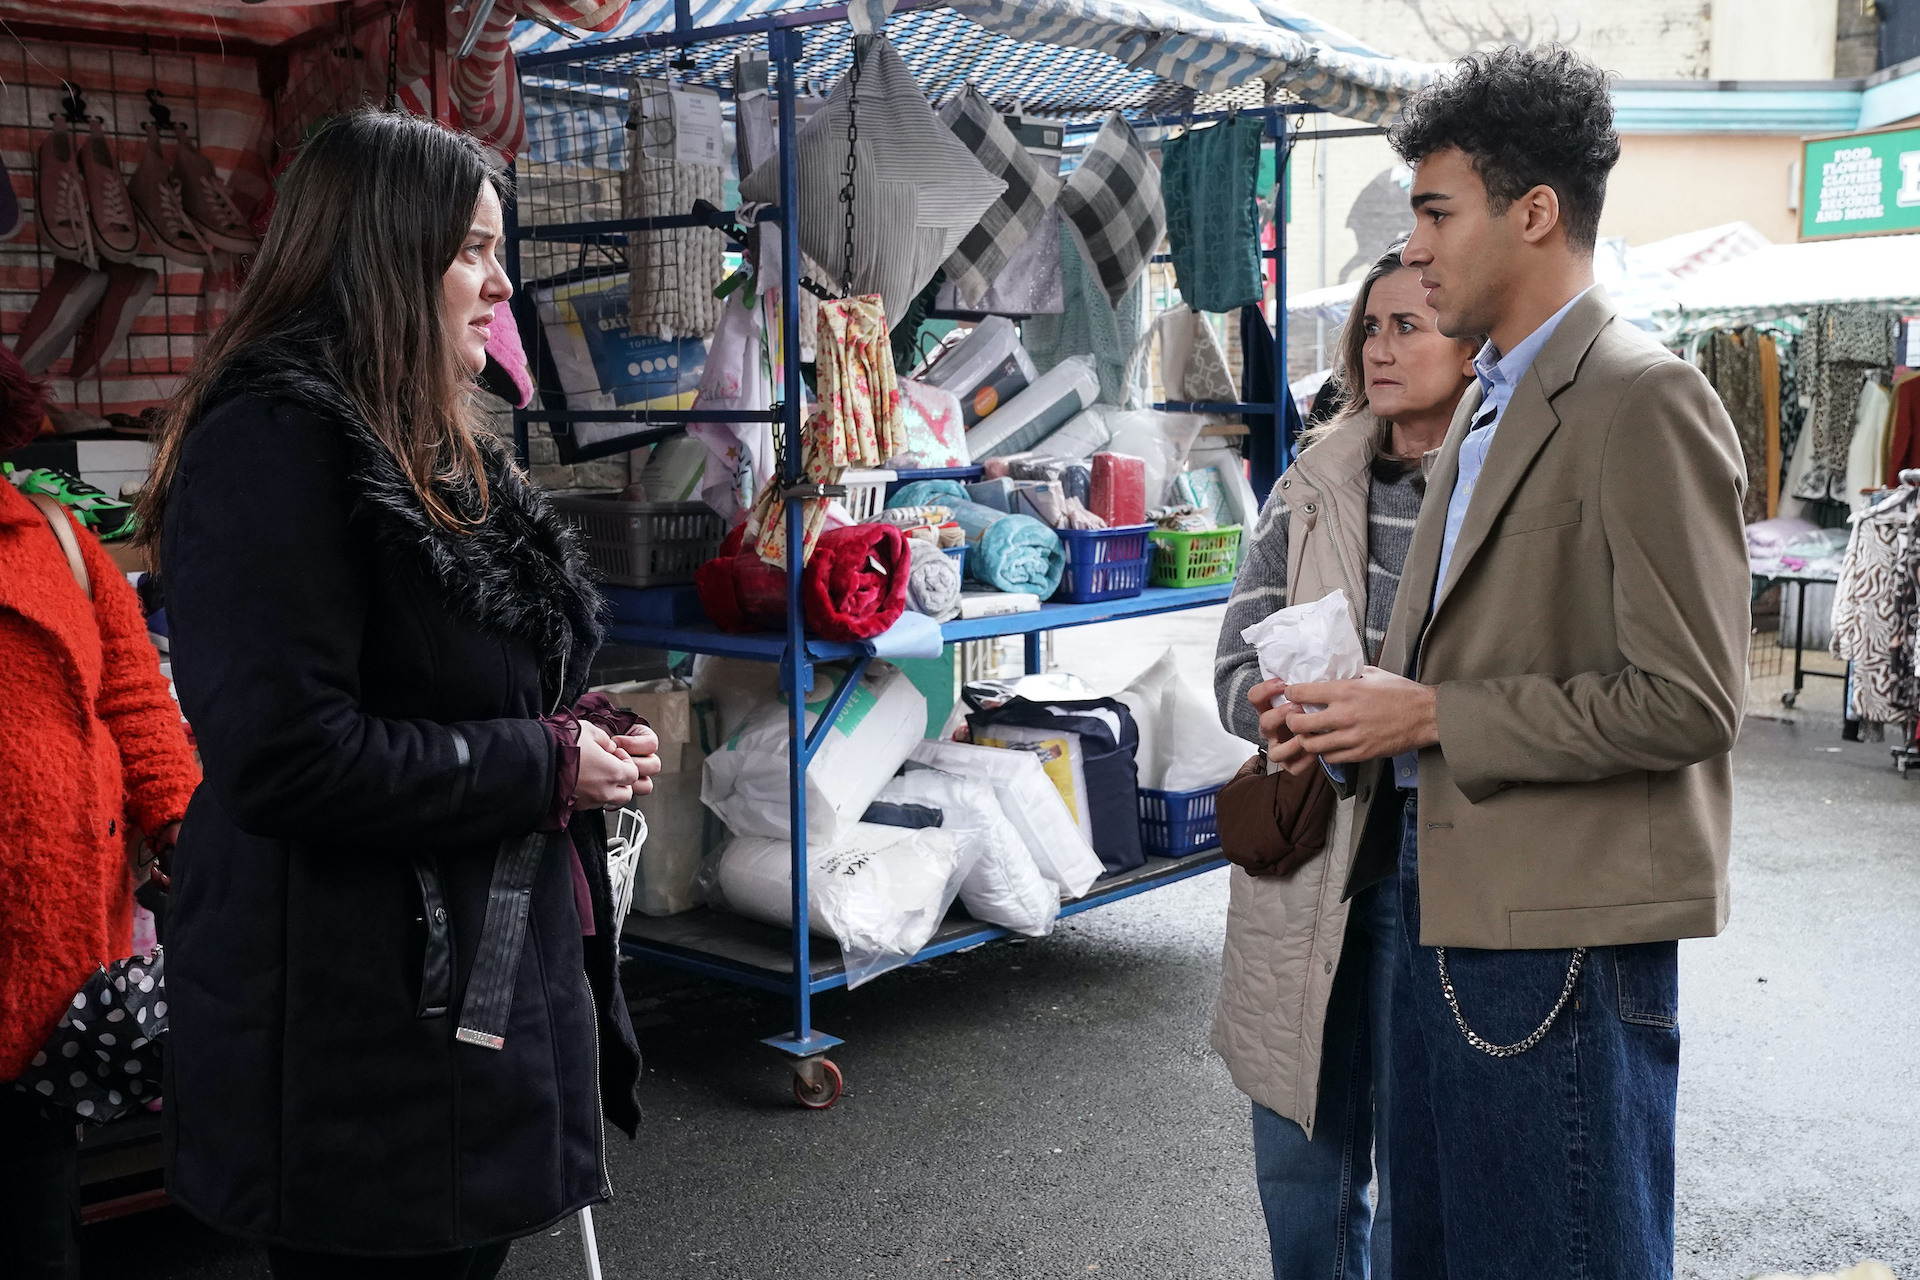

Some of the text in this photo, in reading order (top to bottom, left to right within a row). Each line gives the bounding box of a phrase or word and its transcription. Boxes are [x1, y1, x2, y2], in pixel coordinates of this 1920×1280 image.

[1834, 147, 1872, 162] FOOD
[1823, 158, 1882, 175] FLOWERS
[1823, 171, 1880, 186] CLOTHES
[1820, 182, 1882, 198] ANTIQUES
[1821, 194, 1880, 210] RECORDS
[1815, 205, 1884, 222] AND MORE
[629, 338, 660, 349] TOPPE
[836, 690, 862, 722] DUVET
